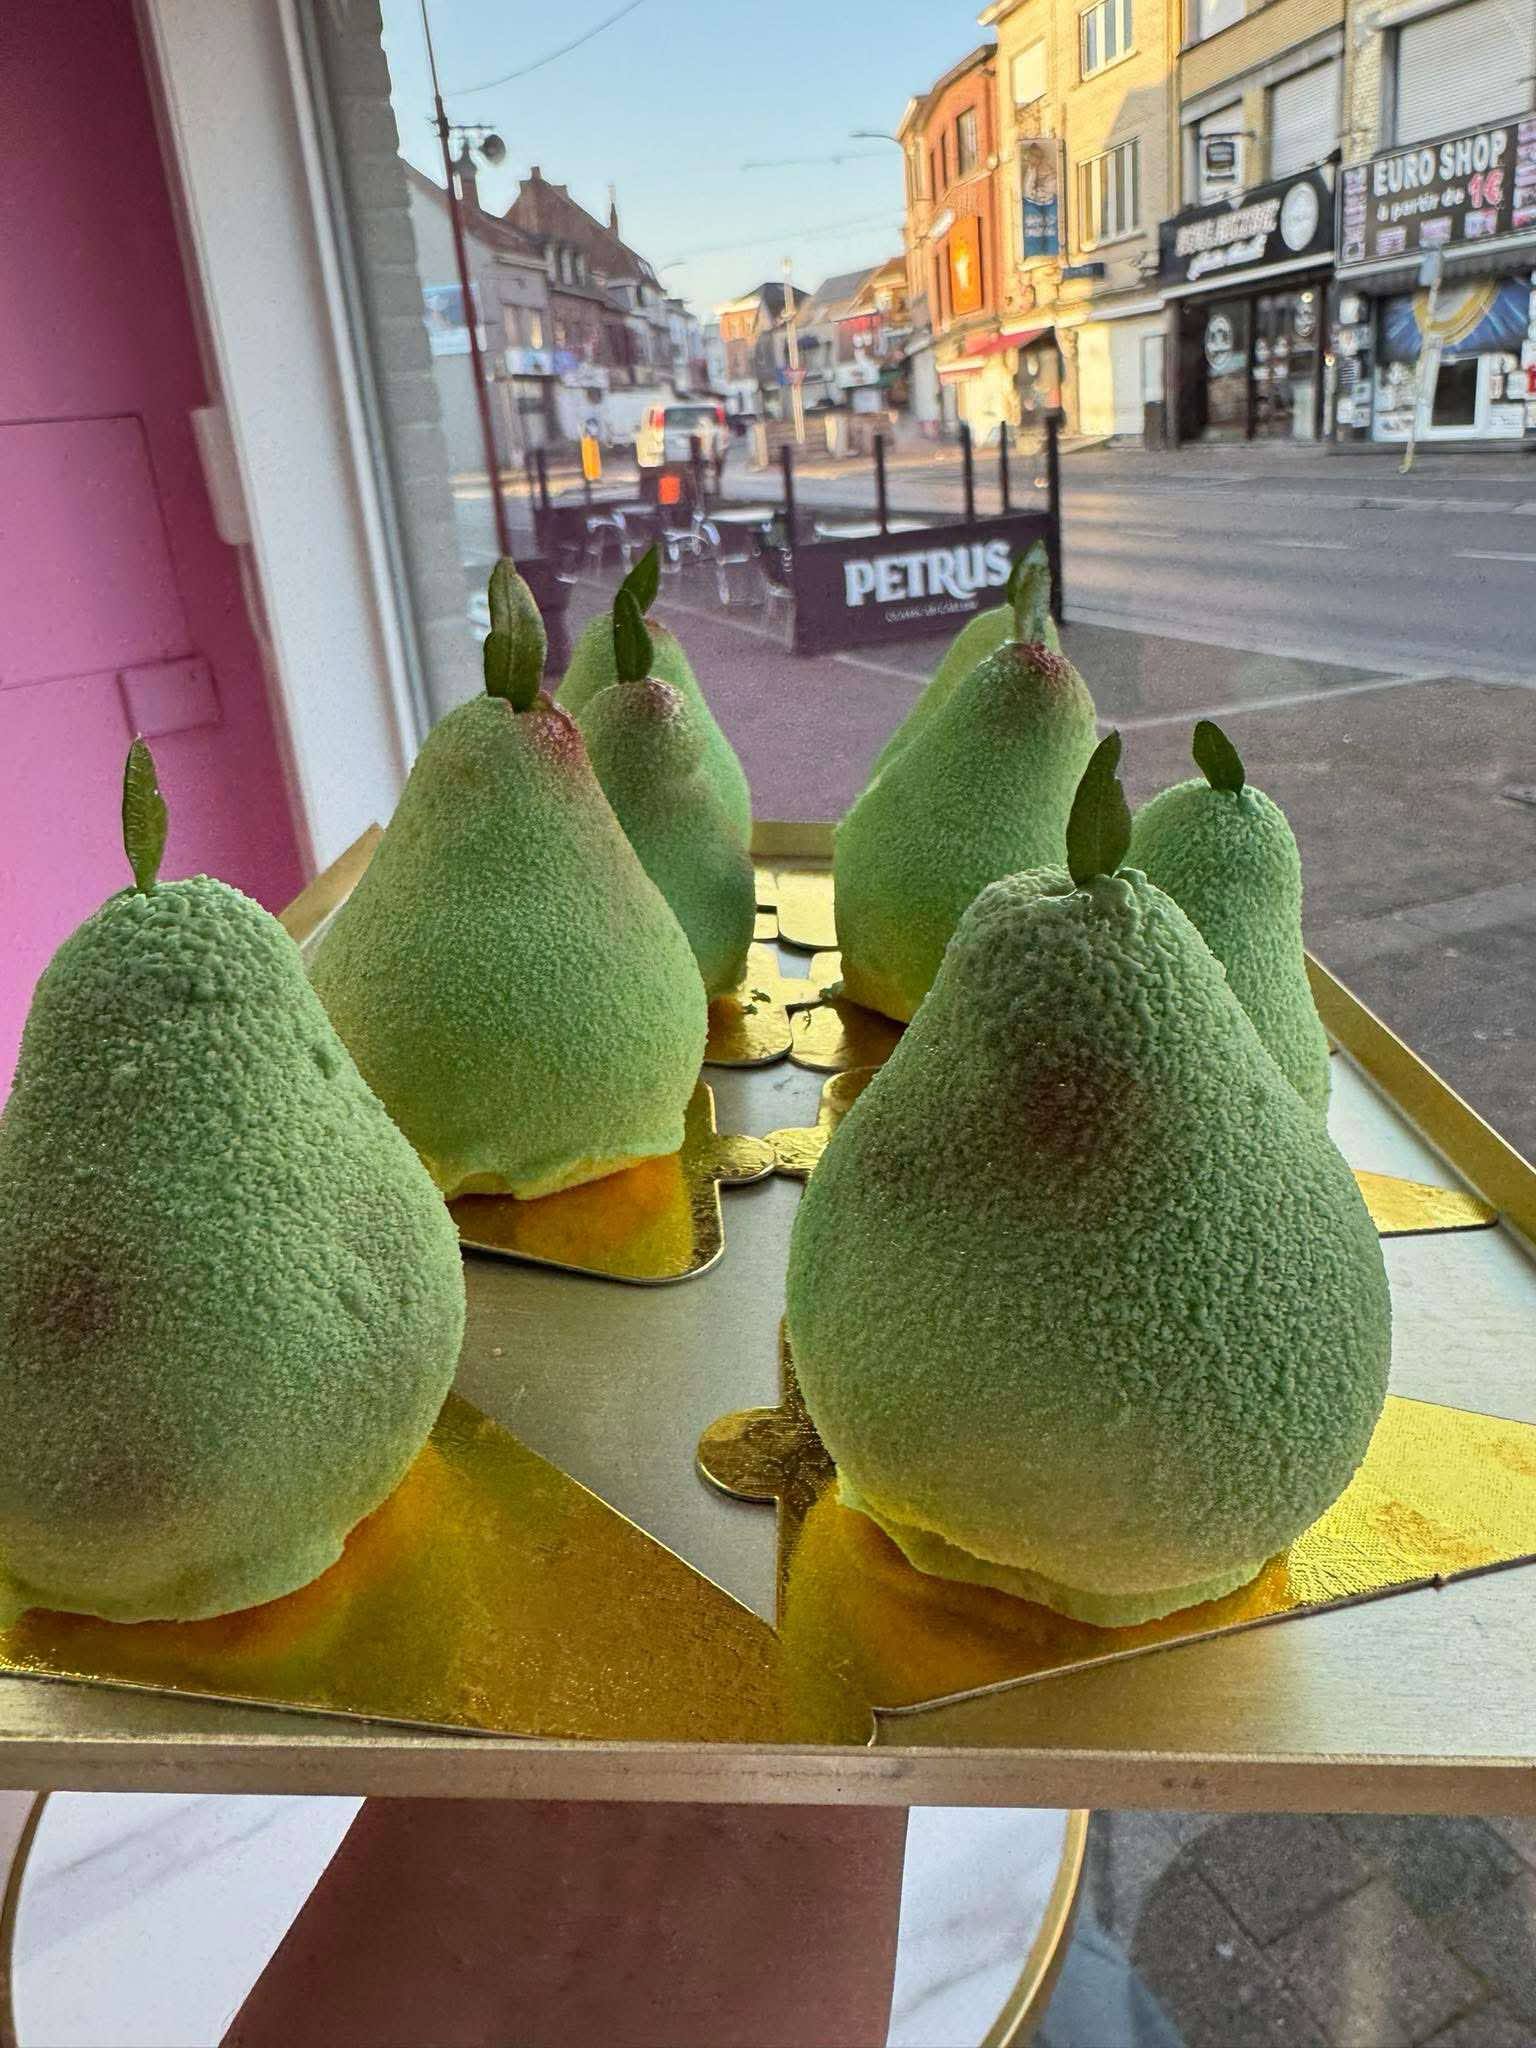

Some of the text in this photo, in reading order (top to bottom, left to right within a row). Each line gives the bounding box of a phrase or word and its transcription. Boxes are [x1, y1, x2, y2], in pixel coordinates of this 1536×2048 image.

[1373, 149, 1436, 197] EURO
[1439, 129, 1508, 181] SHOP
[1467, 168, 1505, 209] 1€
[843, 538, 1012, 608] PETRUS
